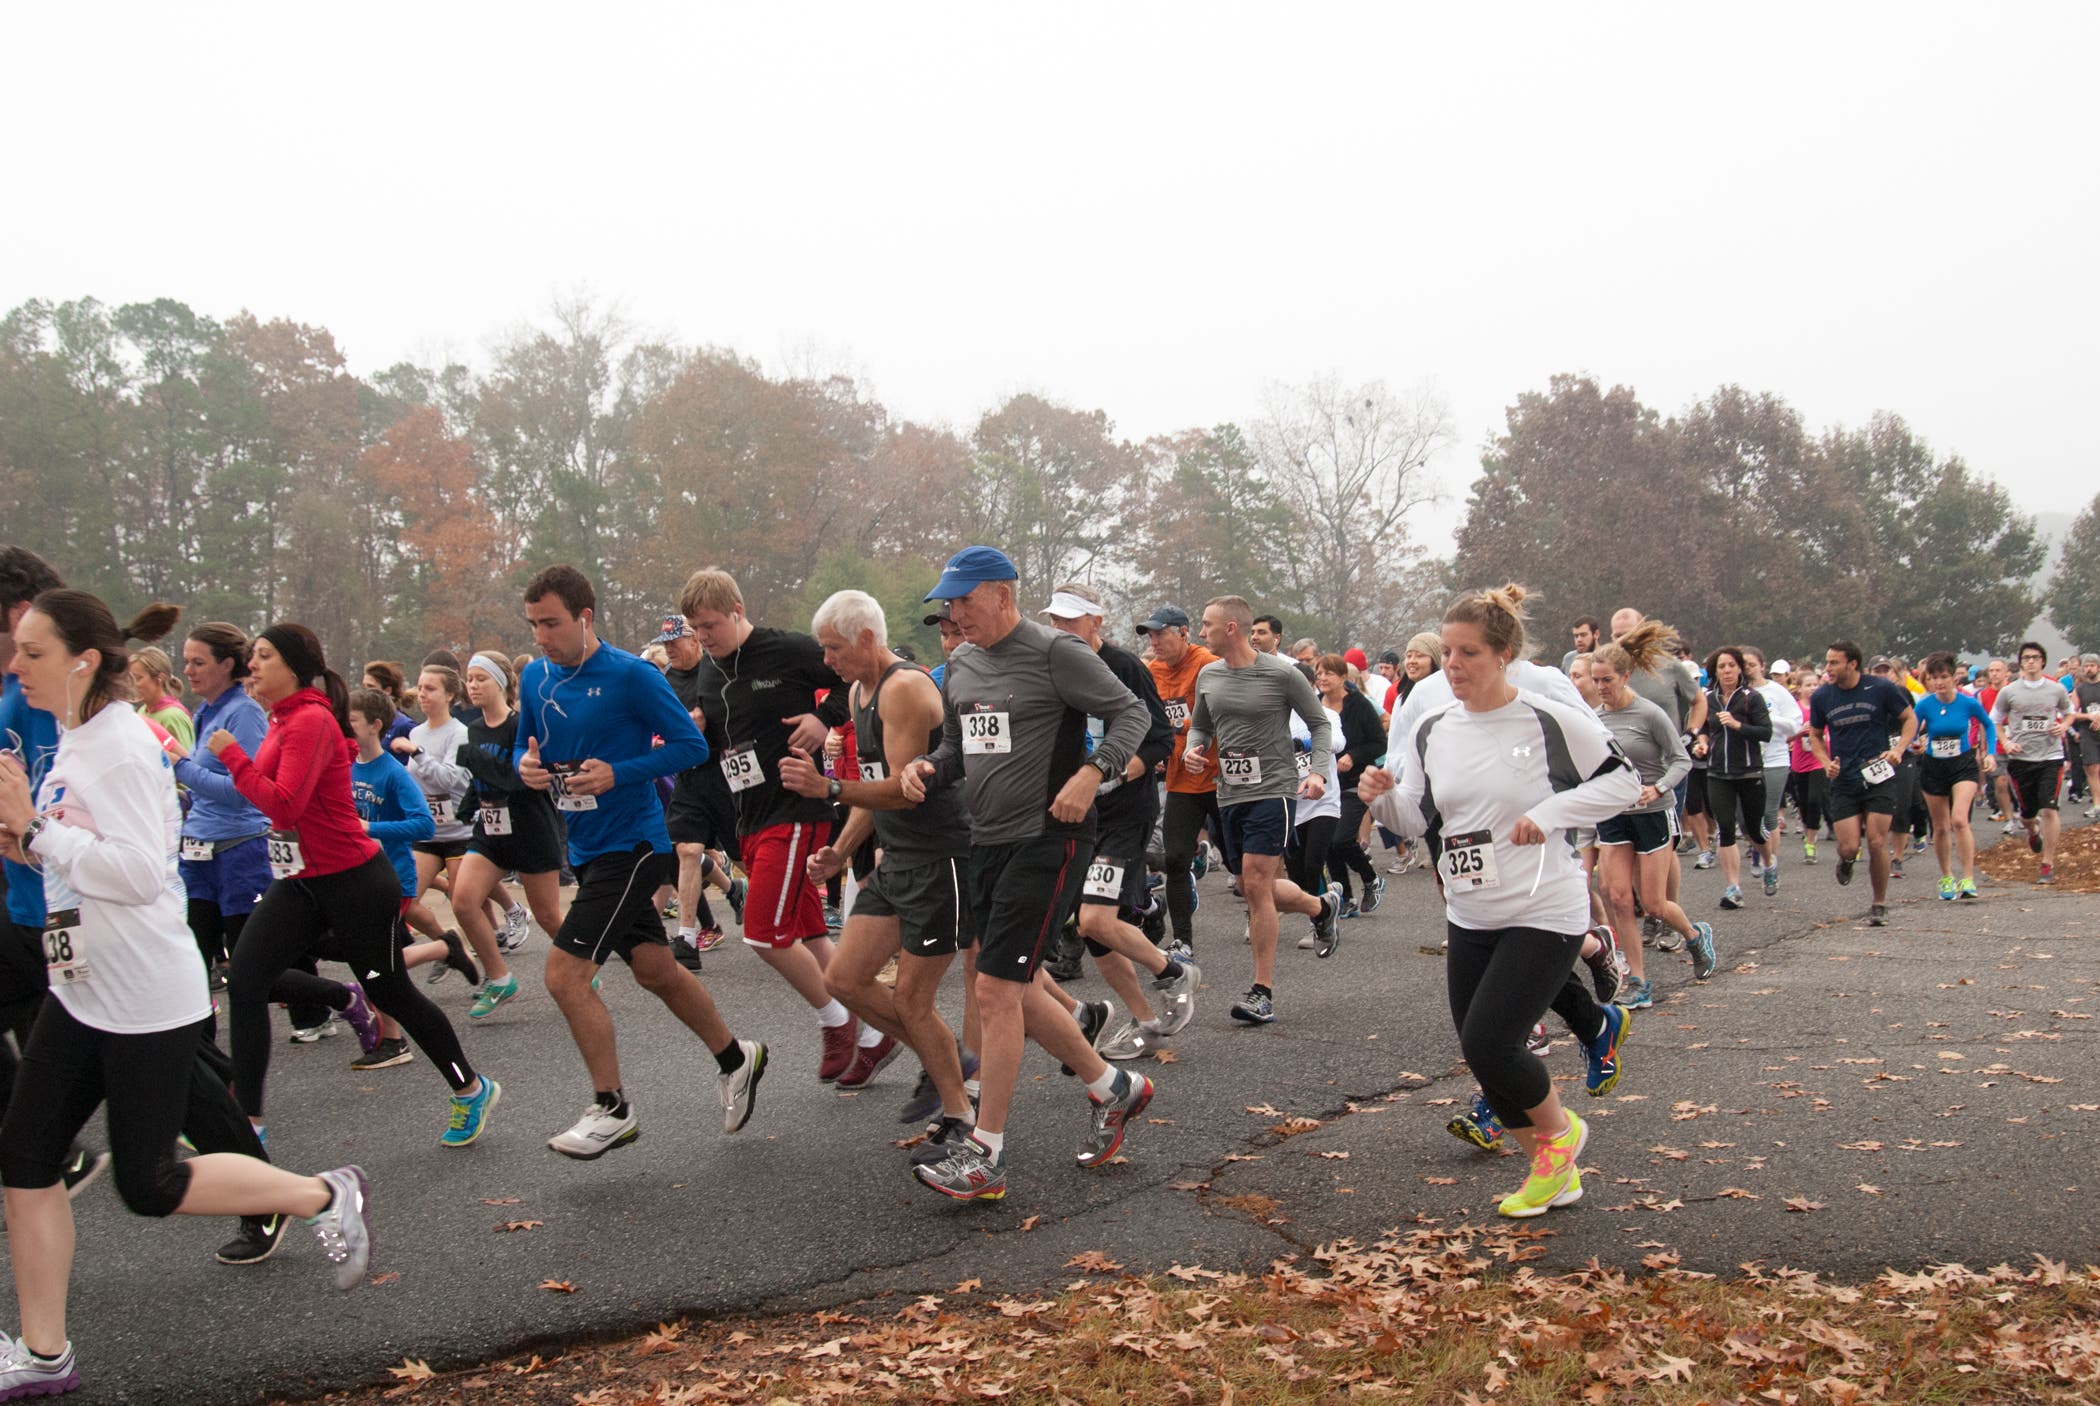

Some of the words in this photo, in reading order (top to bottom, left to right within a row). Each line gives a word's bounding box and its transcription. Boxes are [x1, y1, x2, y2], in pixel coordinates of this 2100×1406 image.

[970, 715, 1000, 737] 338
[2027, 721, 2045, 730] 802
[1225, 759, 1253, 775] 273
[1869, 760, 1888, 777] 137
[482, 810, 502, 824] 67
[1449, 848, 1484, 876] 325
